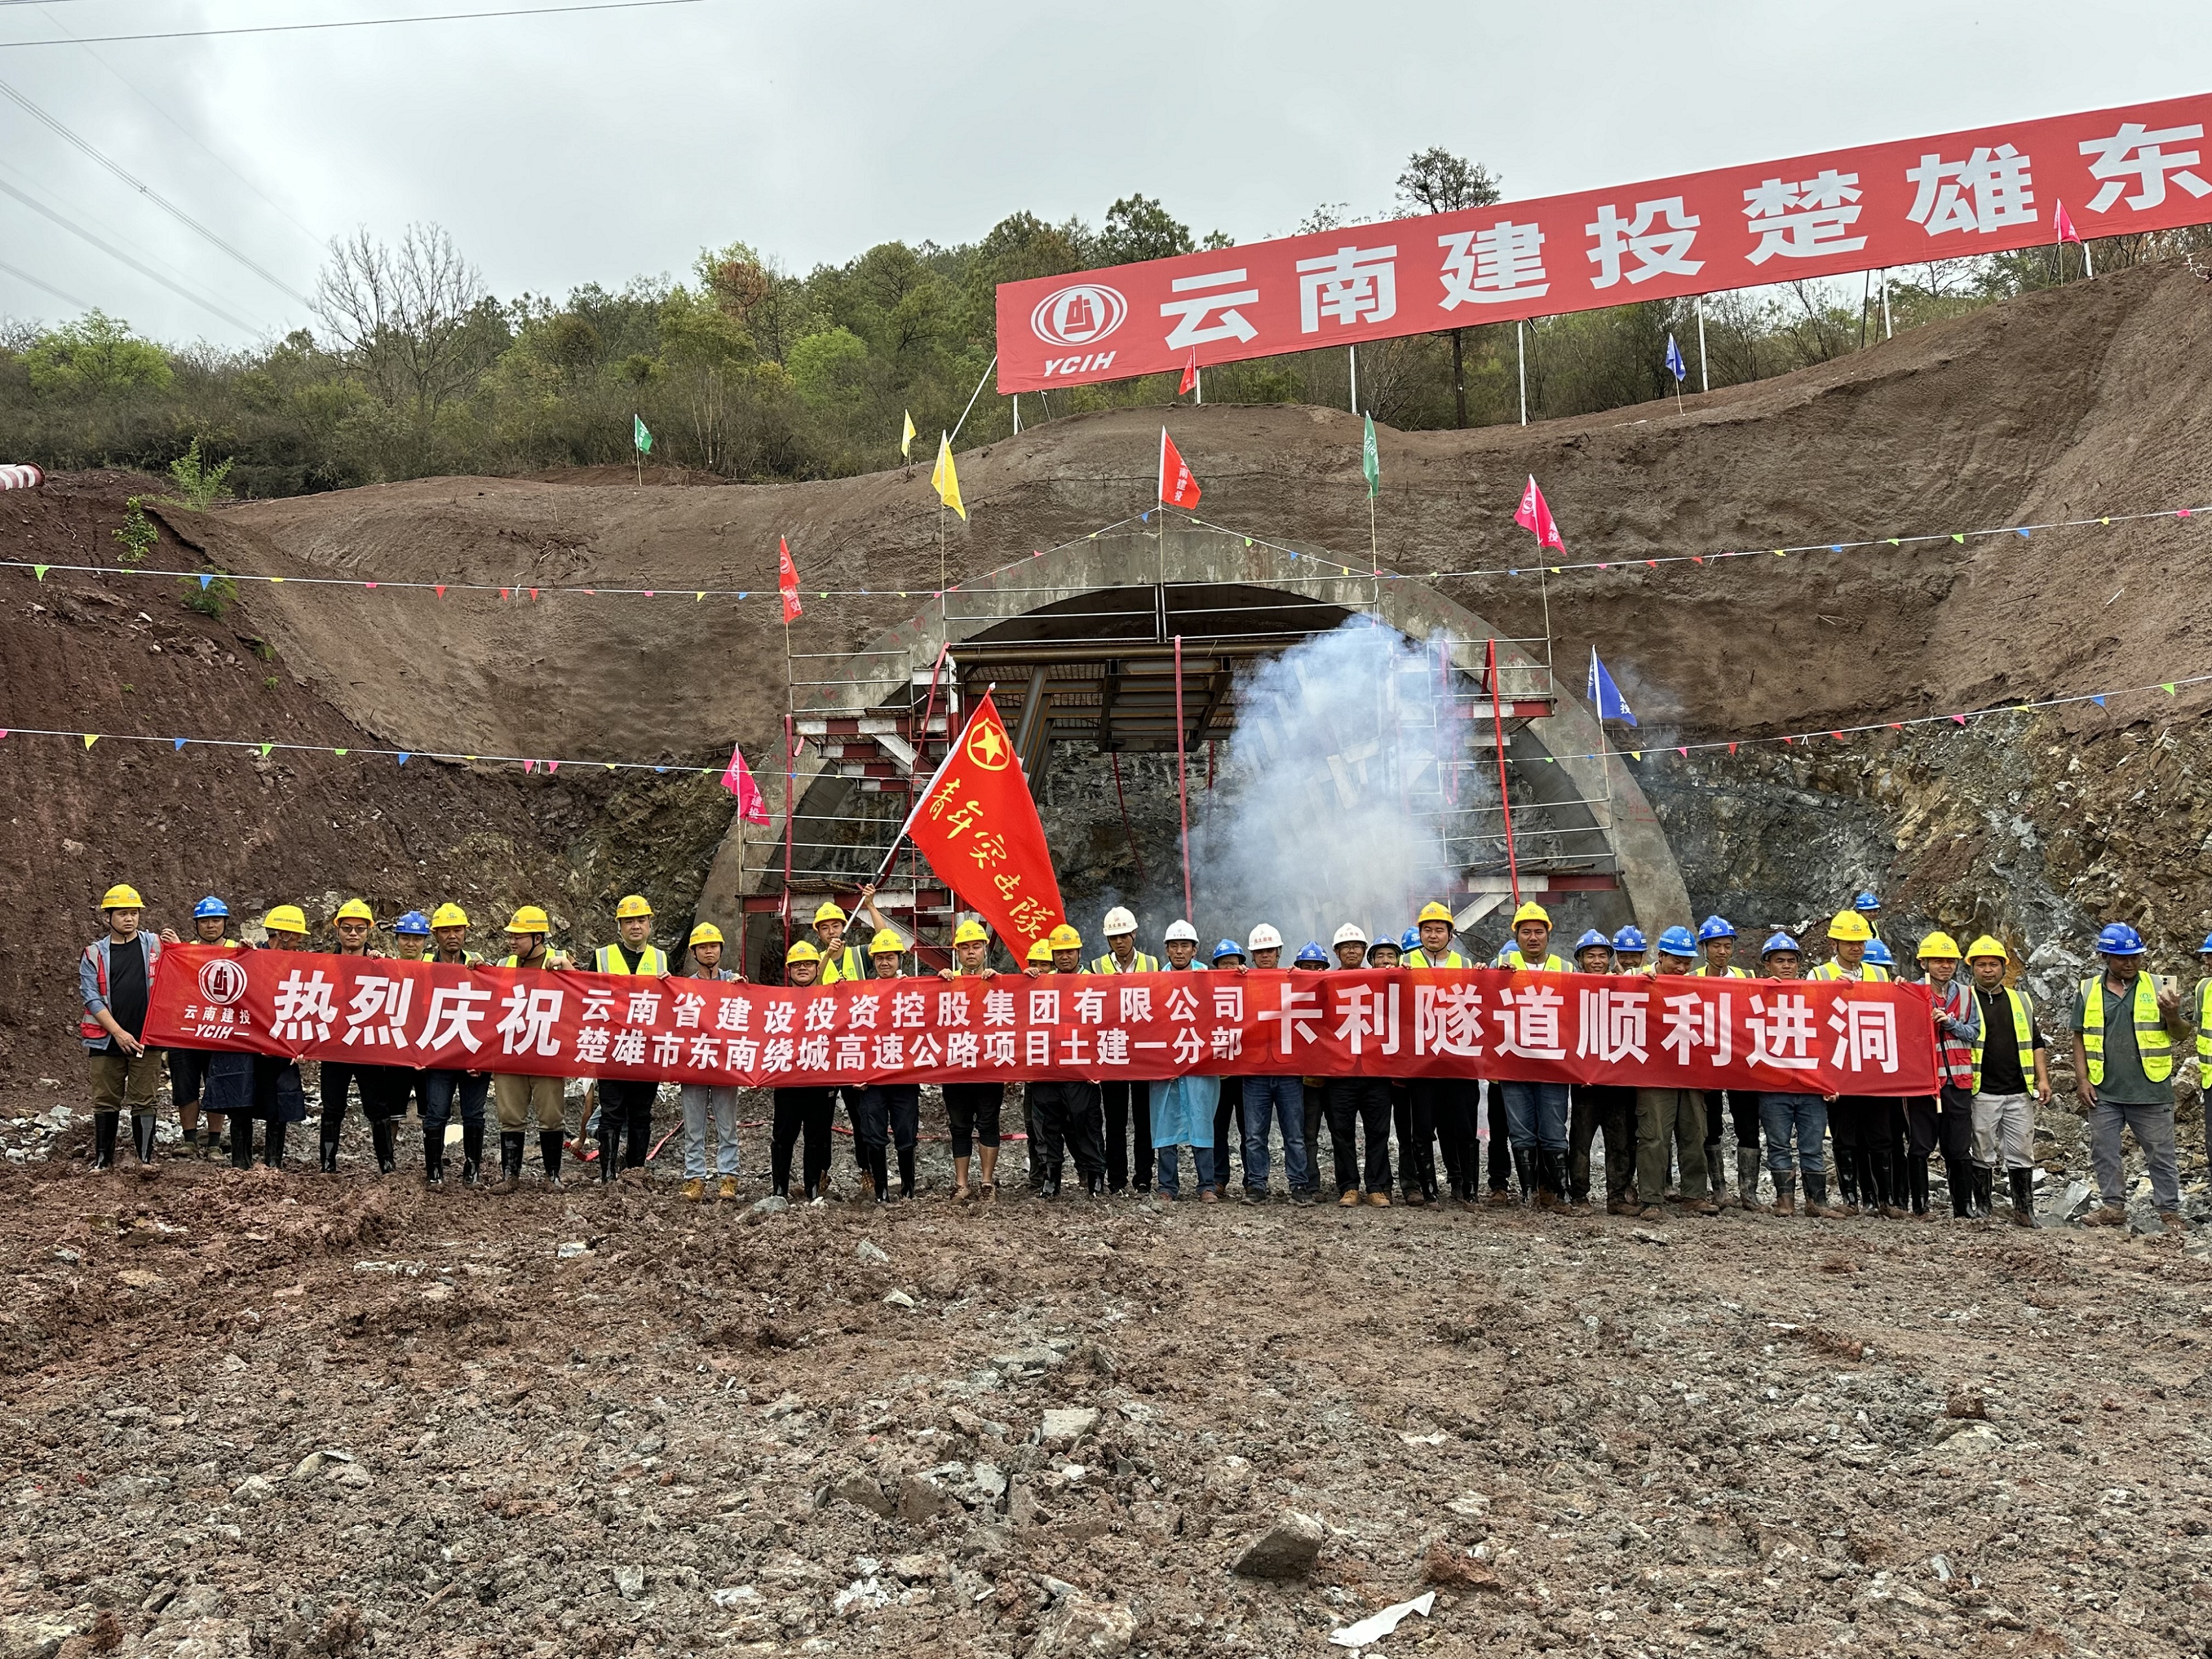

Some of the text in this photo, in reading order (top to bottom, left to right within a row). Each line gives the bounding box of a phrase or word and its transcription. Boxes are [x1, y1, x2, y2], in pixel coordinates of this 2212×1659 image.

[1161, 123, 2212, 351] 云南建投楚雄东
[1044, 351, 1116, 377] YCIH
[184, 1005, 252, 1025] 云南建投
[268, 969, 564, 1057] 热烈庆祝
[582, 986, 1244, 1034] 云南省建设投资控股集团有限公司
[1258, 982, 1899, 1073] 卡利隧道顺利进洞
[574, 1025, 1243, 1073] 楚雄市东南绕城高速公路项目土建一分部
